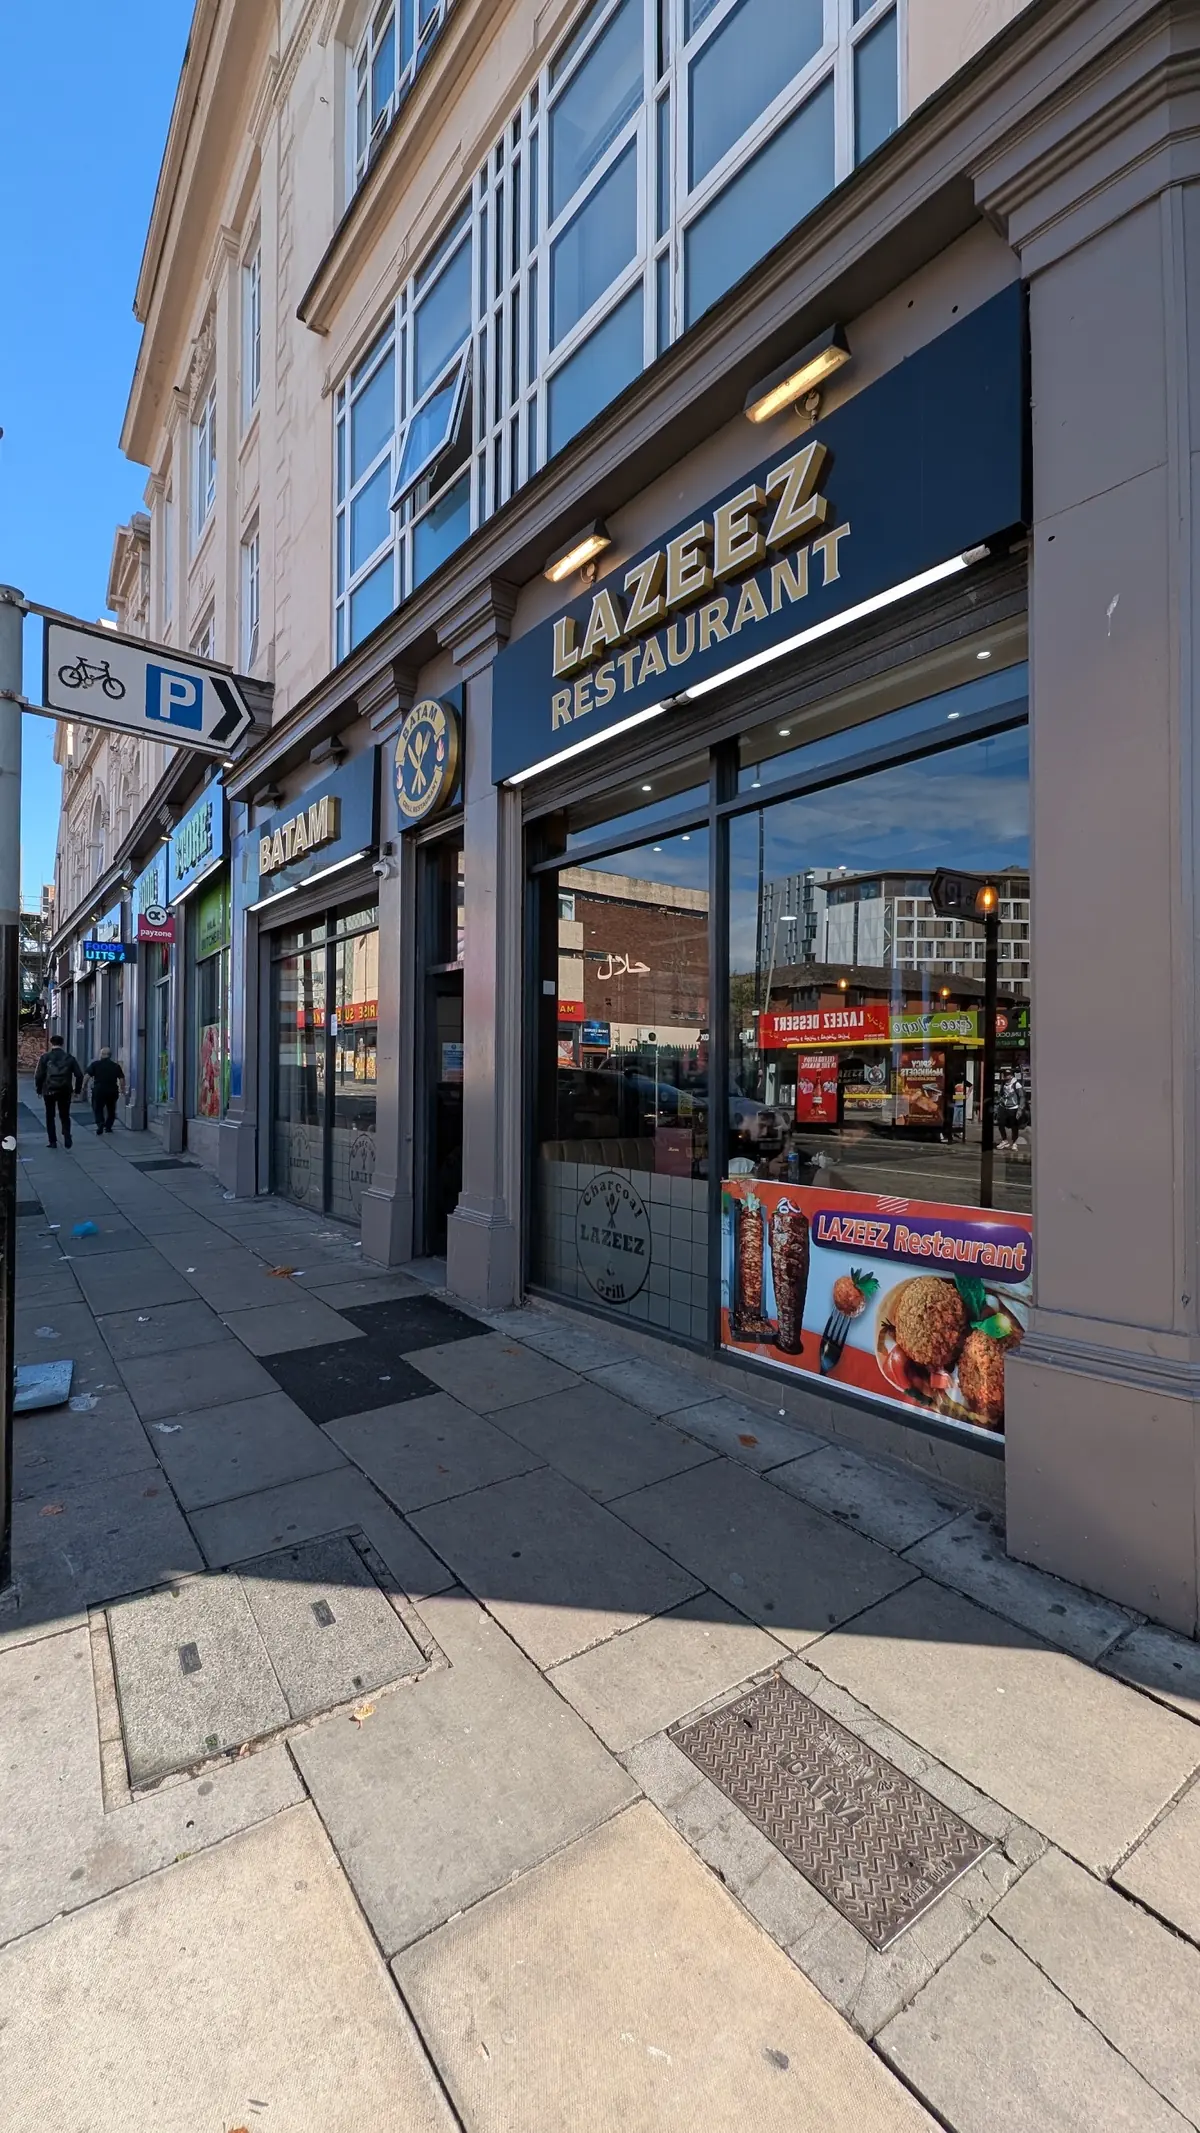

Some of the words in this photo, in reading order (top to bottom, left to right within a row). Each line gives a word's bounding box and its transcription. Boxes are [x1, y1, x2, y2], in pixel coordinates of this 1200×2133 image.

[552, 440, 828, 679] LAZEEZ
[551, 522, 852, 731] RESTAURANT
[160, 672, 196, 719] P
[402, 705, 438, 740] BATAM
[259, 795, 337, 876] BATAM
[85, 943, 124, 952] FOODS
[140, 929, 173, 938] payzone
[85, 951, 116, 961] UITS
[597, 953, 651, 980] حلال
[583, 1180, 643, 1219] Charcoal
[580, 1223, 645, 1256] LAZEEZ
[817, 1215, 891, 1249] LAZEEZ
[893, 1224, 1028, 1272] Restaurant
[597, 1278, 626, 1299] Grill
[787, 1761, 858, 1816] CATV
